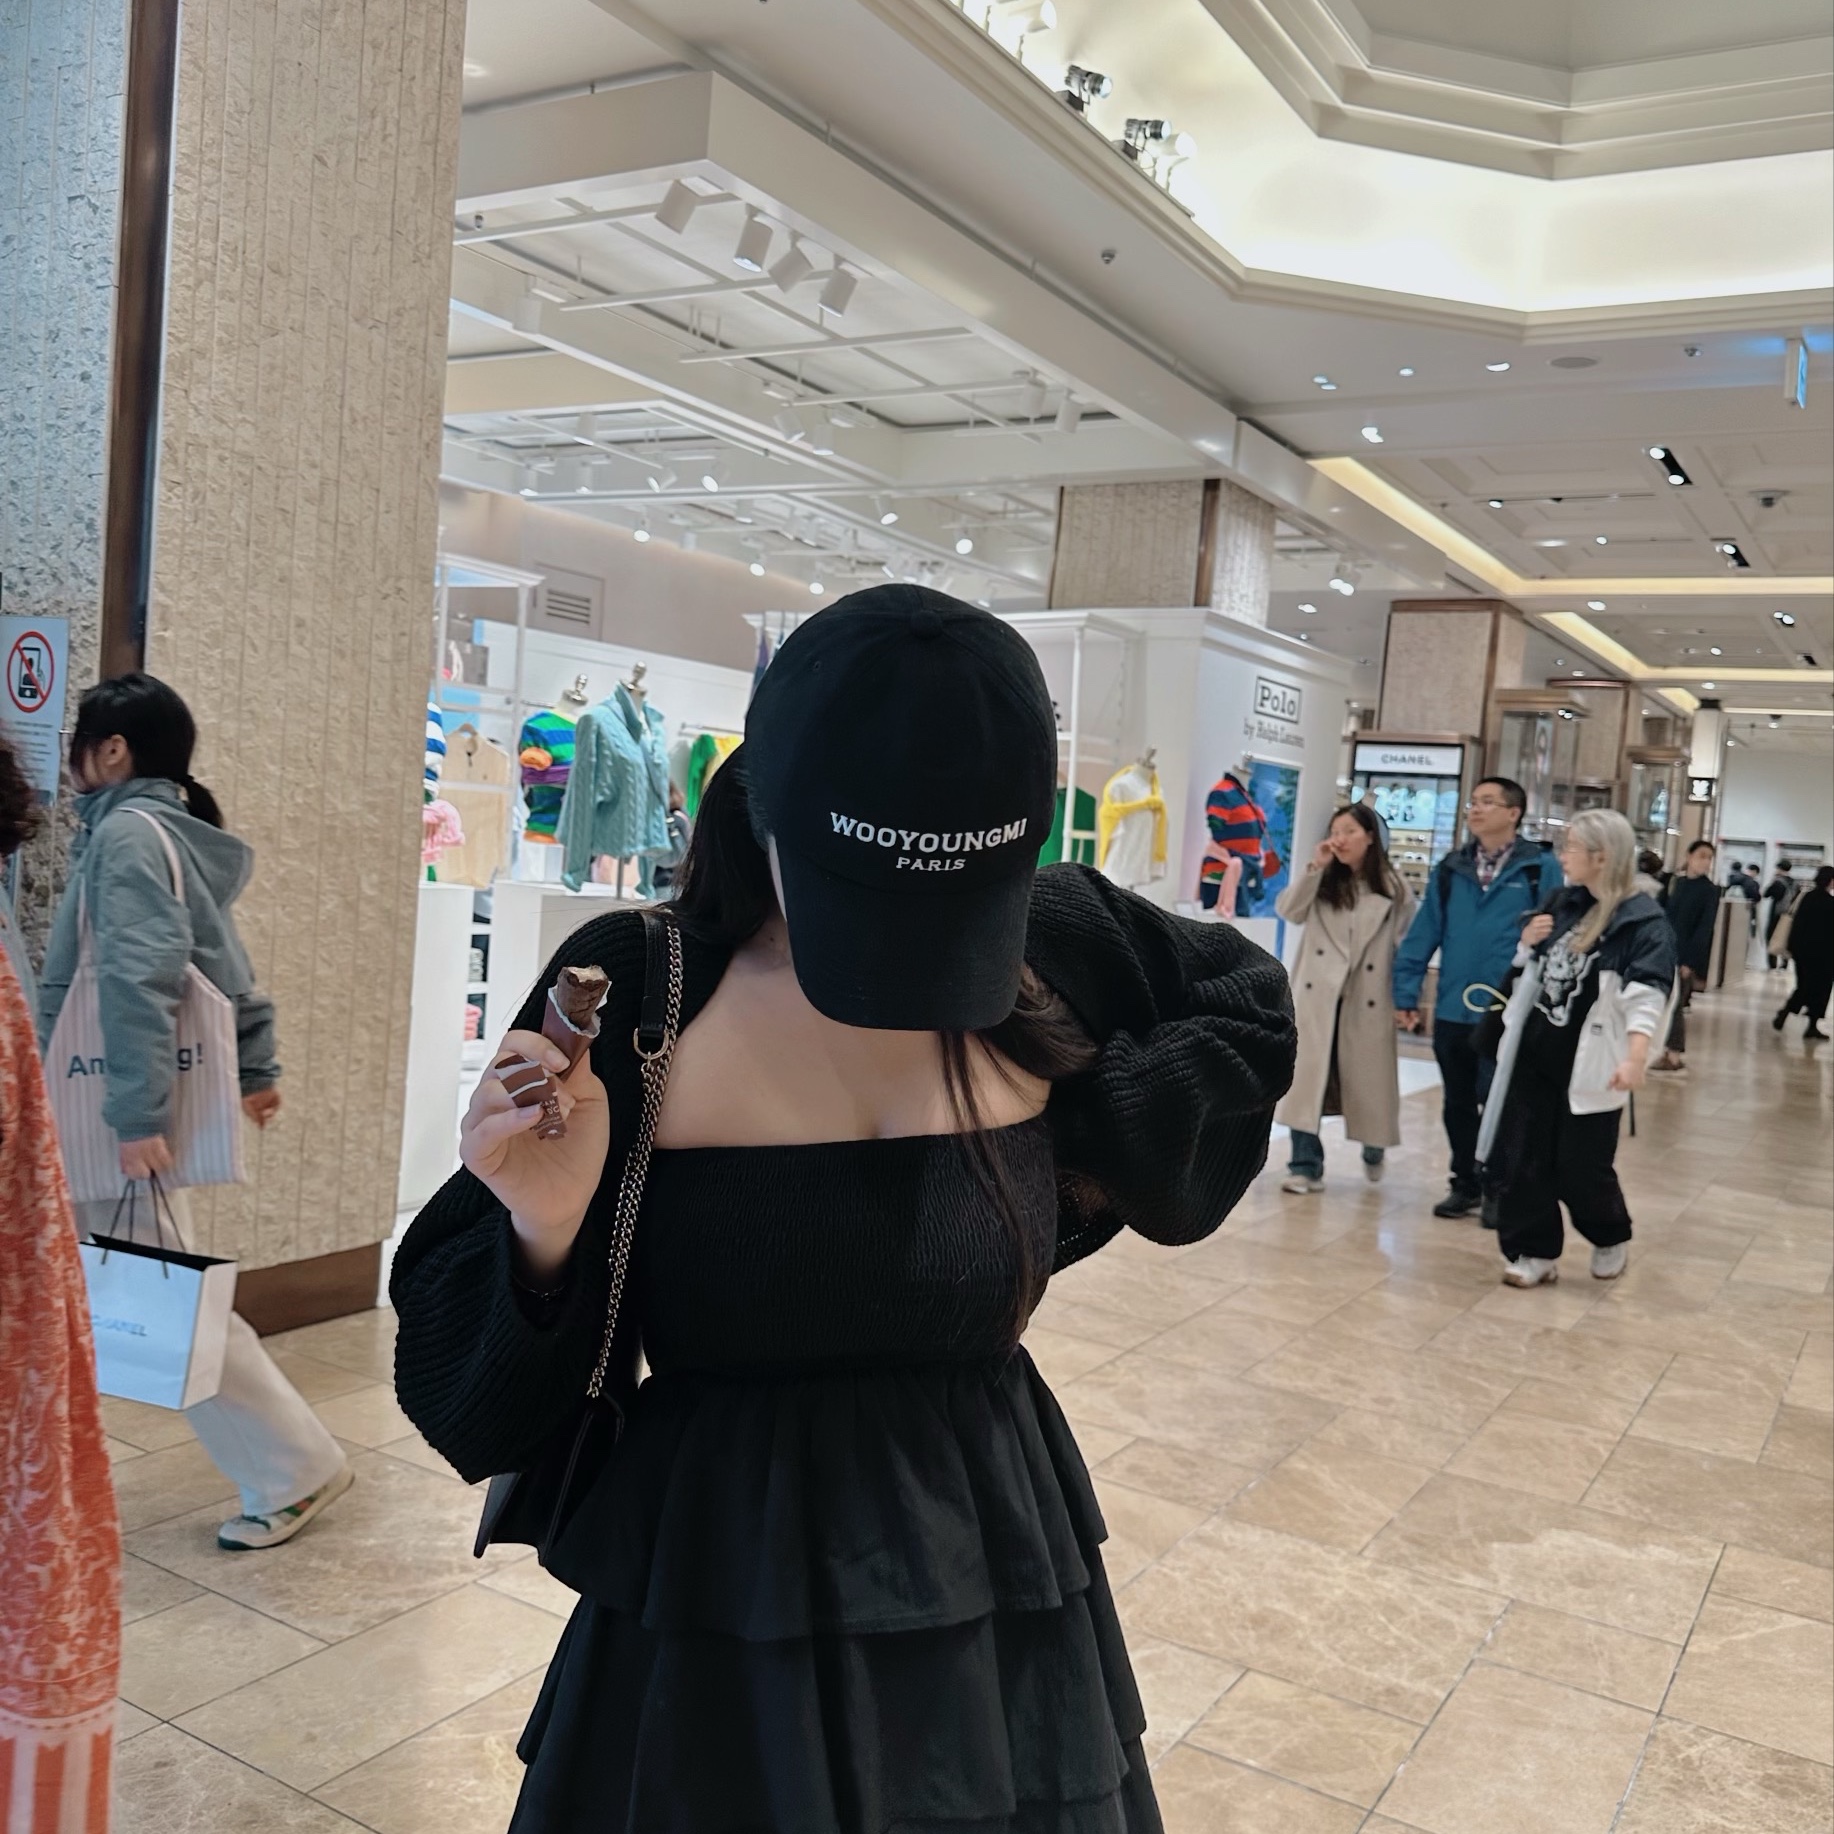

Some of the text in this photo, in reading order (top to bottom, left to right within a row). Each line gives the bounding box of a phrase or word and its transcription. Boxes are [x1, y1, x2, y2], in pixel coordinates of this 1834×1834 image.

[1259, 685, 1296, 716] Polo
[1381, 753, 1434, 766] CHANEL
[830, 811, 1027, 853] WOOYOUNGMI
[896, 857, 966, 871] PARIS
